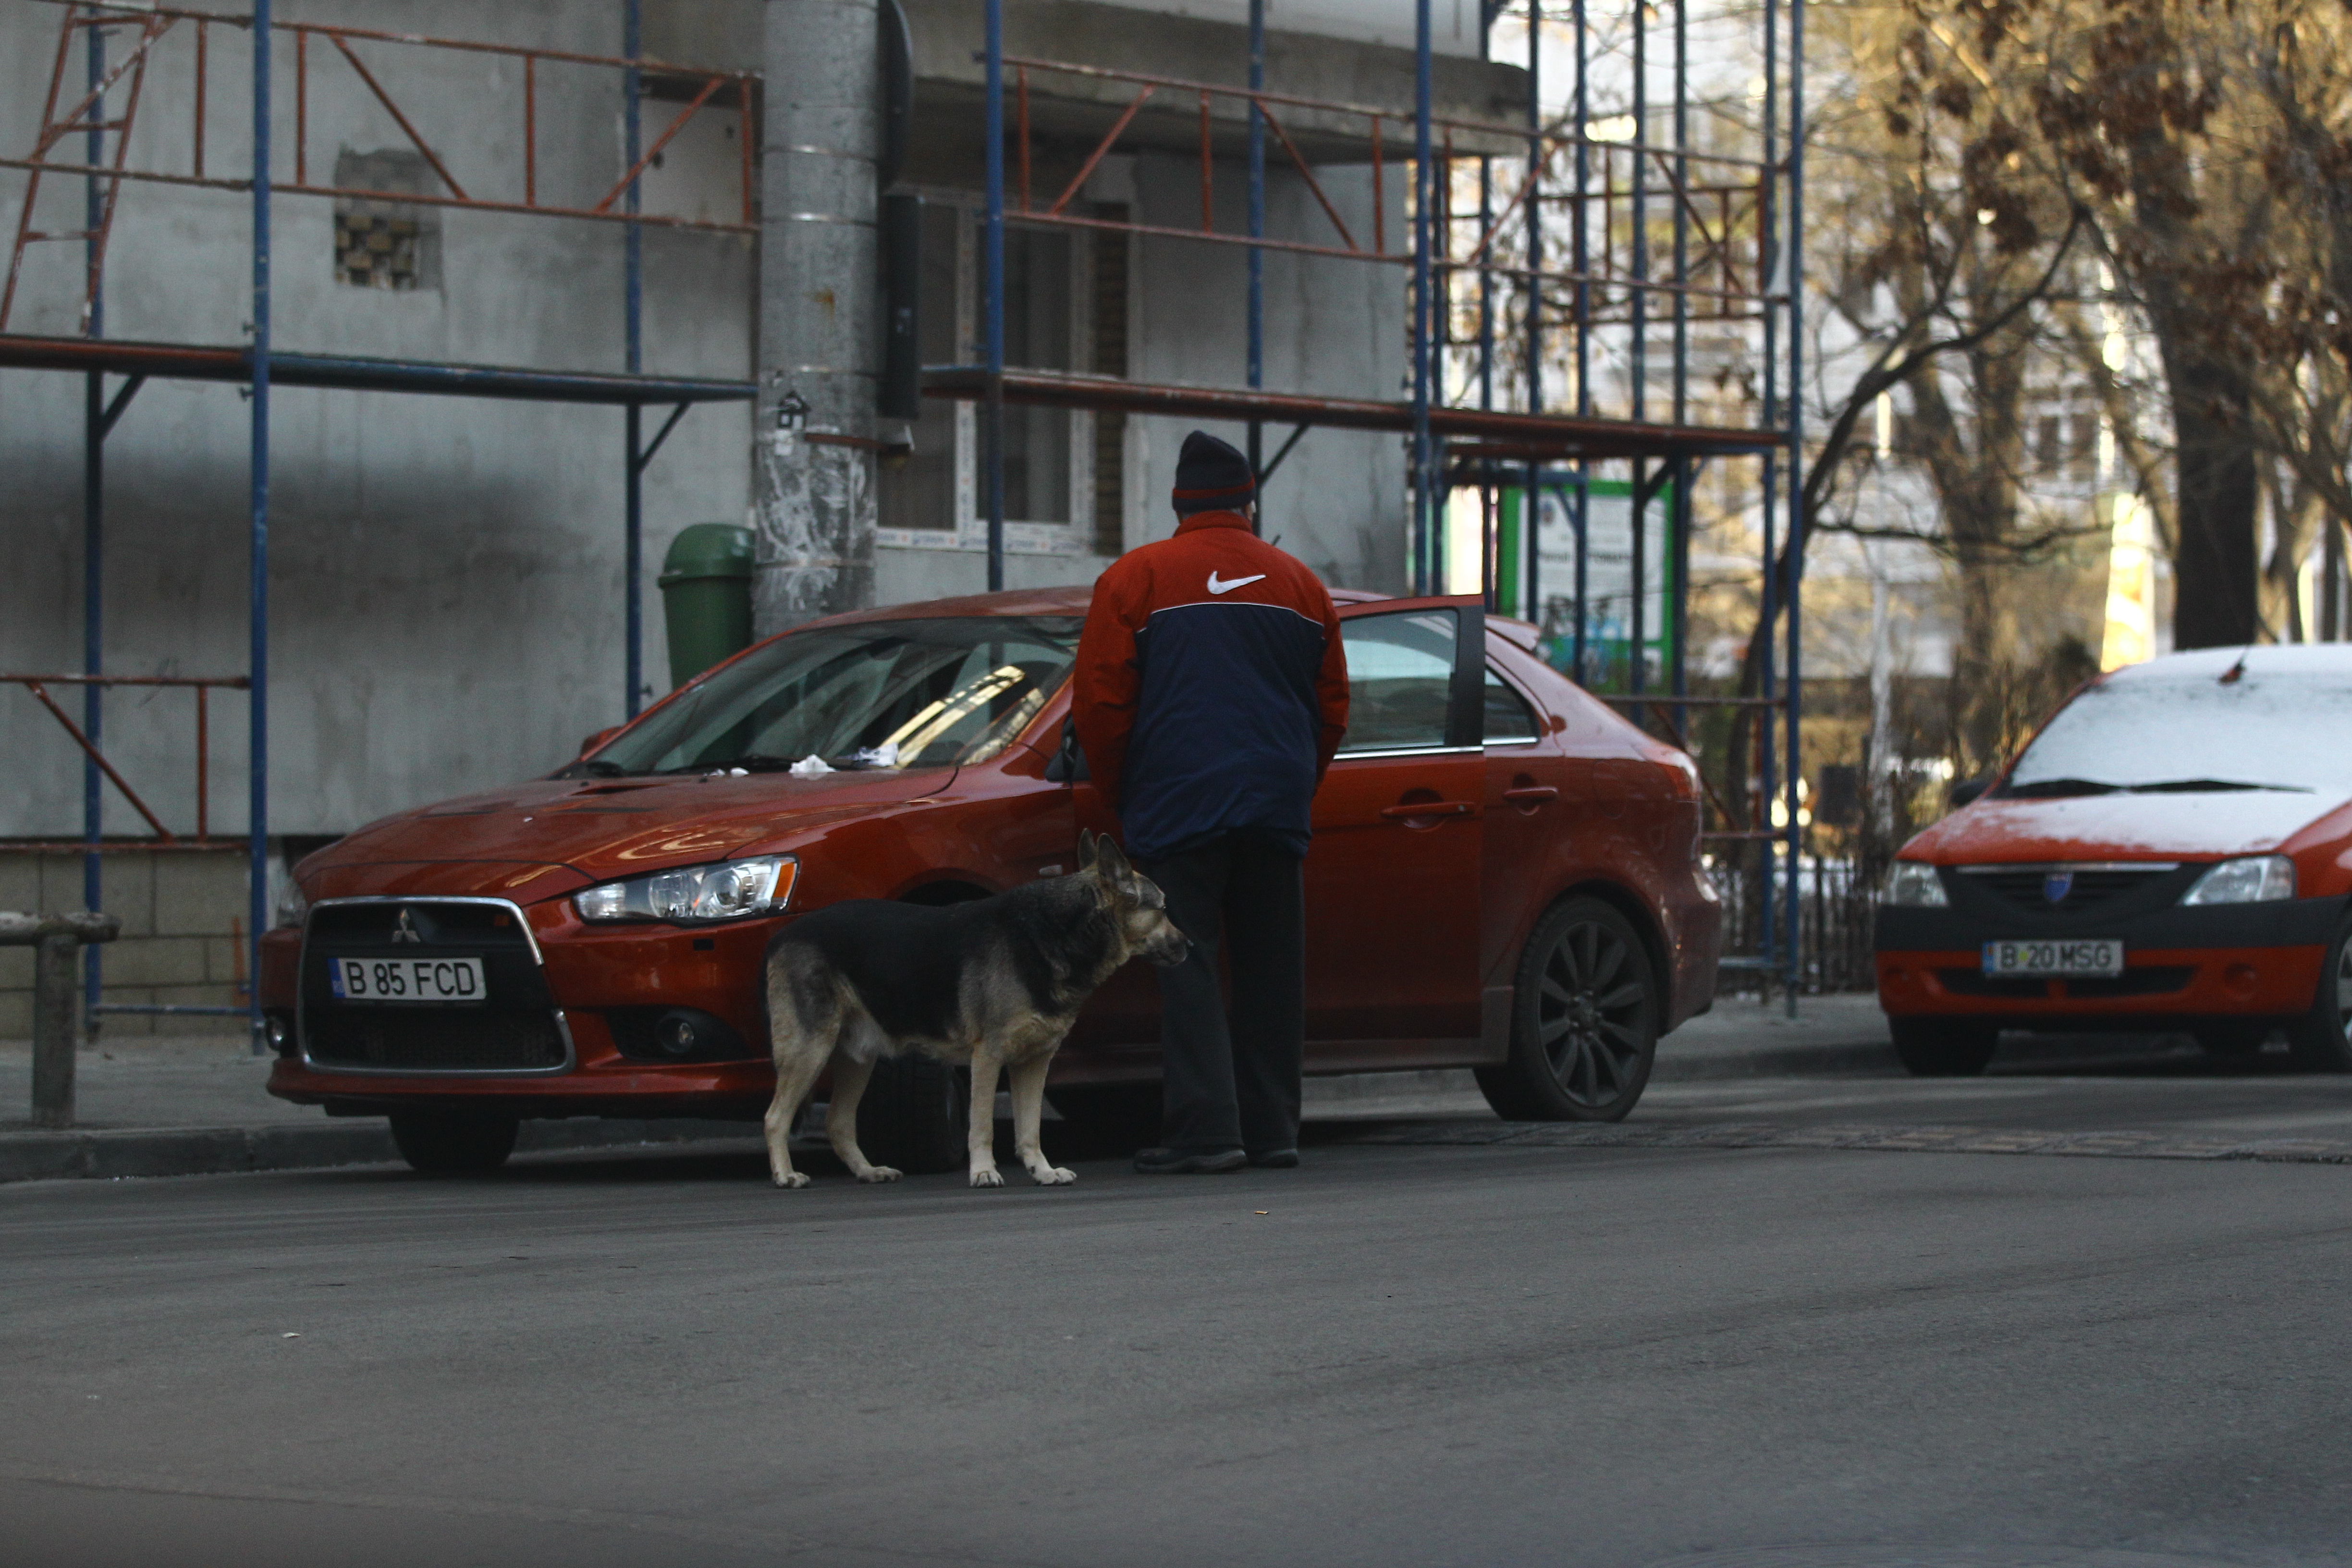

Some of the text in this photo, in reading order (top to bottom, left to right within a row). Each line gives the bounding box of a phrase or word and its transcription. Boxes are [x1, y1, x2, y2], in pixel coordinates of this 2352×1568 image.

[2000, 944, 2111, 968] B 20 MSG
[346, 962, 476, 995] B 85 FCD
